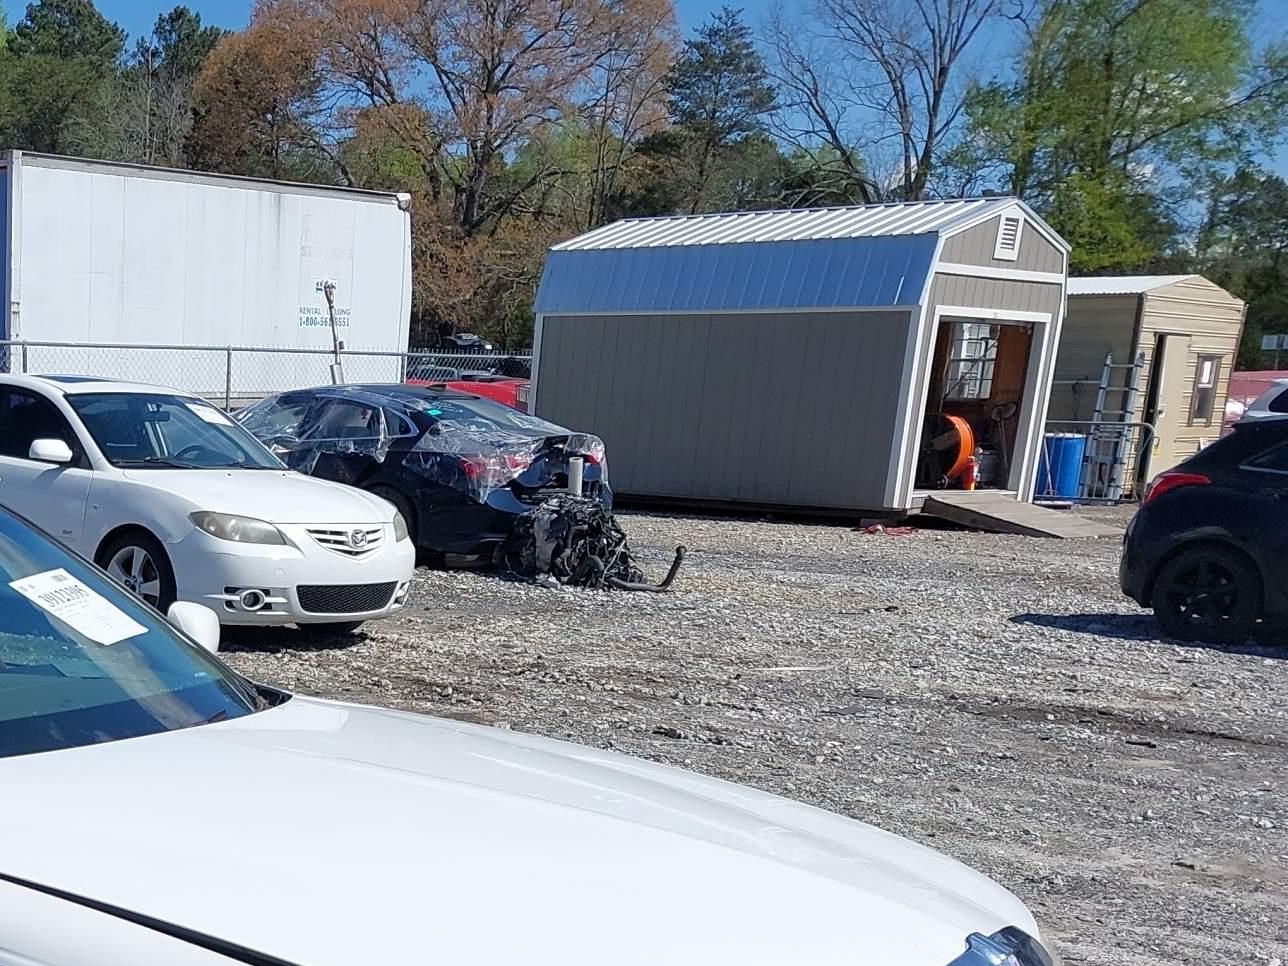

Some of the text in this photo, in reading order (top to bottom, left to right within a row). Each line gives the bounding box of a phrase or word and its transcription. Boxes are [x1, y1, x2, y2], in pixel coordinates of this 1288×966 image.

[299, 306, 352, 316] RENTAL LASING
[37, 584, 91, 608] 39123395
